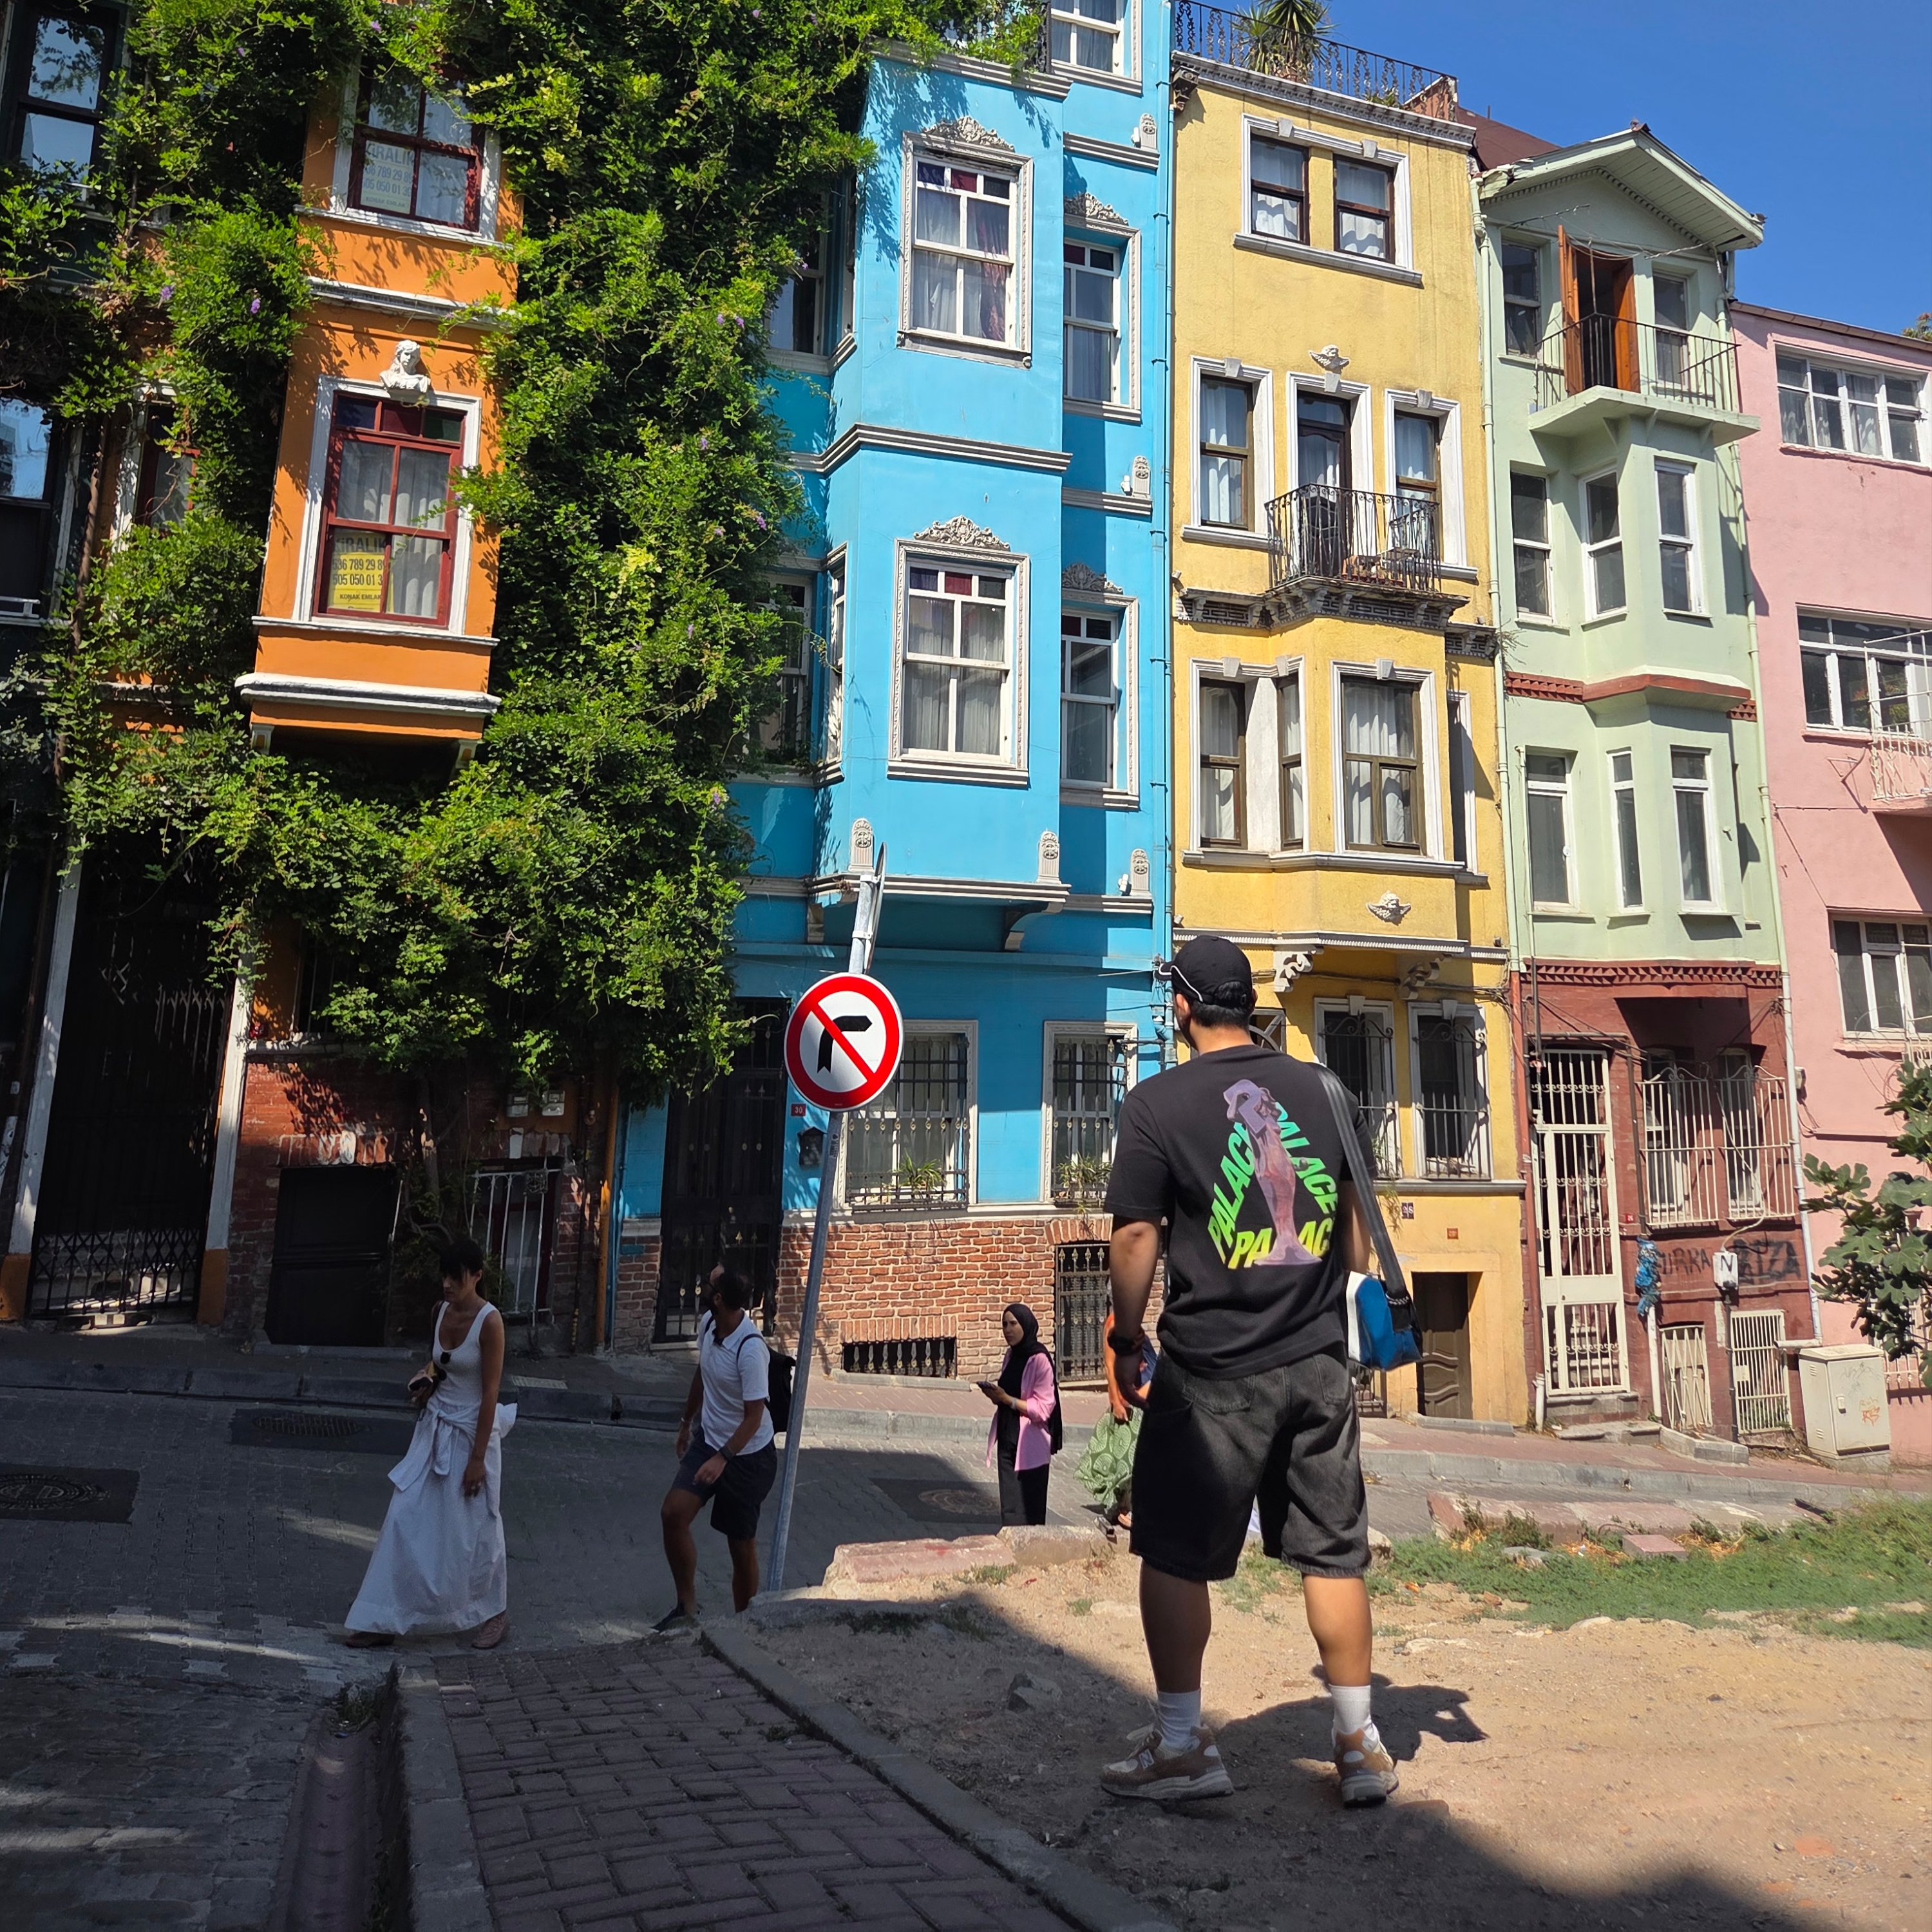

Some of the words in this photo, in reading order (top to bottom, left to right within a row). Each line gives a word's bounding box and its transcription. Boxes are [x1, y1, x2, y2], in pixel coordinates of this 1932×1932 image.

[377, 166, 392, 178] 789
[393, 169, 402, 182] 29
[376, 181, 390, 193] 050
[332, 558, 348, 571] 536
[349, 558, 364, 571] 789
[366, 558, 375, 571] 29
[377, 558, 385, 571] 8
[333, 573, 348, 586] 505
[350, 573, 365, 585] 050
[366, 574, 375, 586] 01
[794, 1106, 803, 1114] 30
